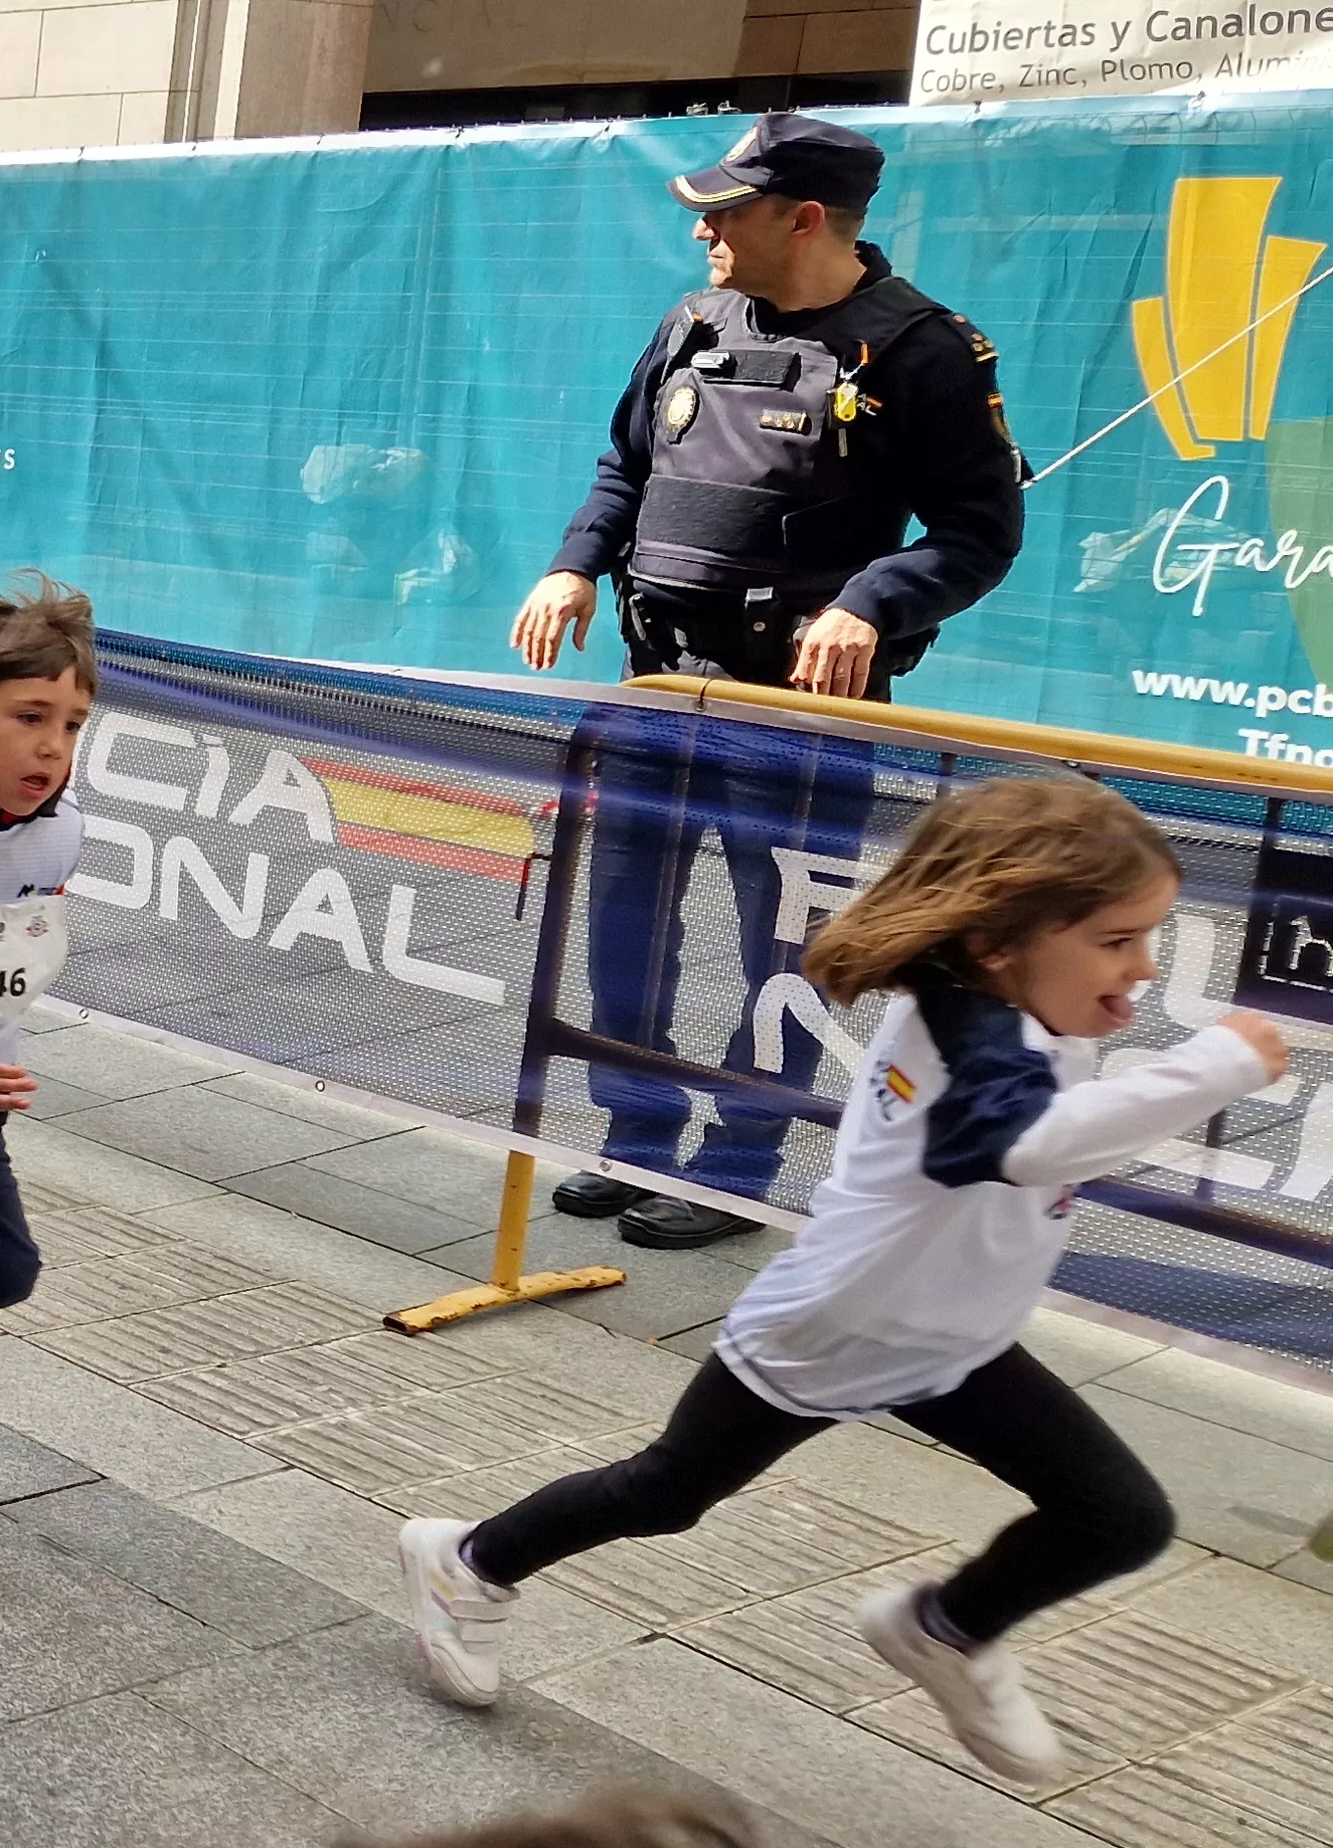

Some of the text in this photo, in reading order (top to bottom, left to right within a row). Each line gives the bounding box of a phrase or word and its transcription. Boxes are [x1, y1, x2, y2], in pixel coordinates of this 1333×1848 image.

[926, 3, 1333, 55] Cubiertas y Canalone
[920, 67, 1005, 94] Cobre,
[1019, 64, 1088, 88] Zinc,
[1101, 59, 1203, 84] Plomo,
[1132, 669, 1333, 718] www.pcb
